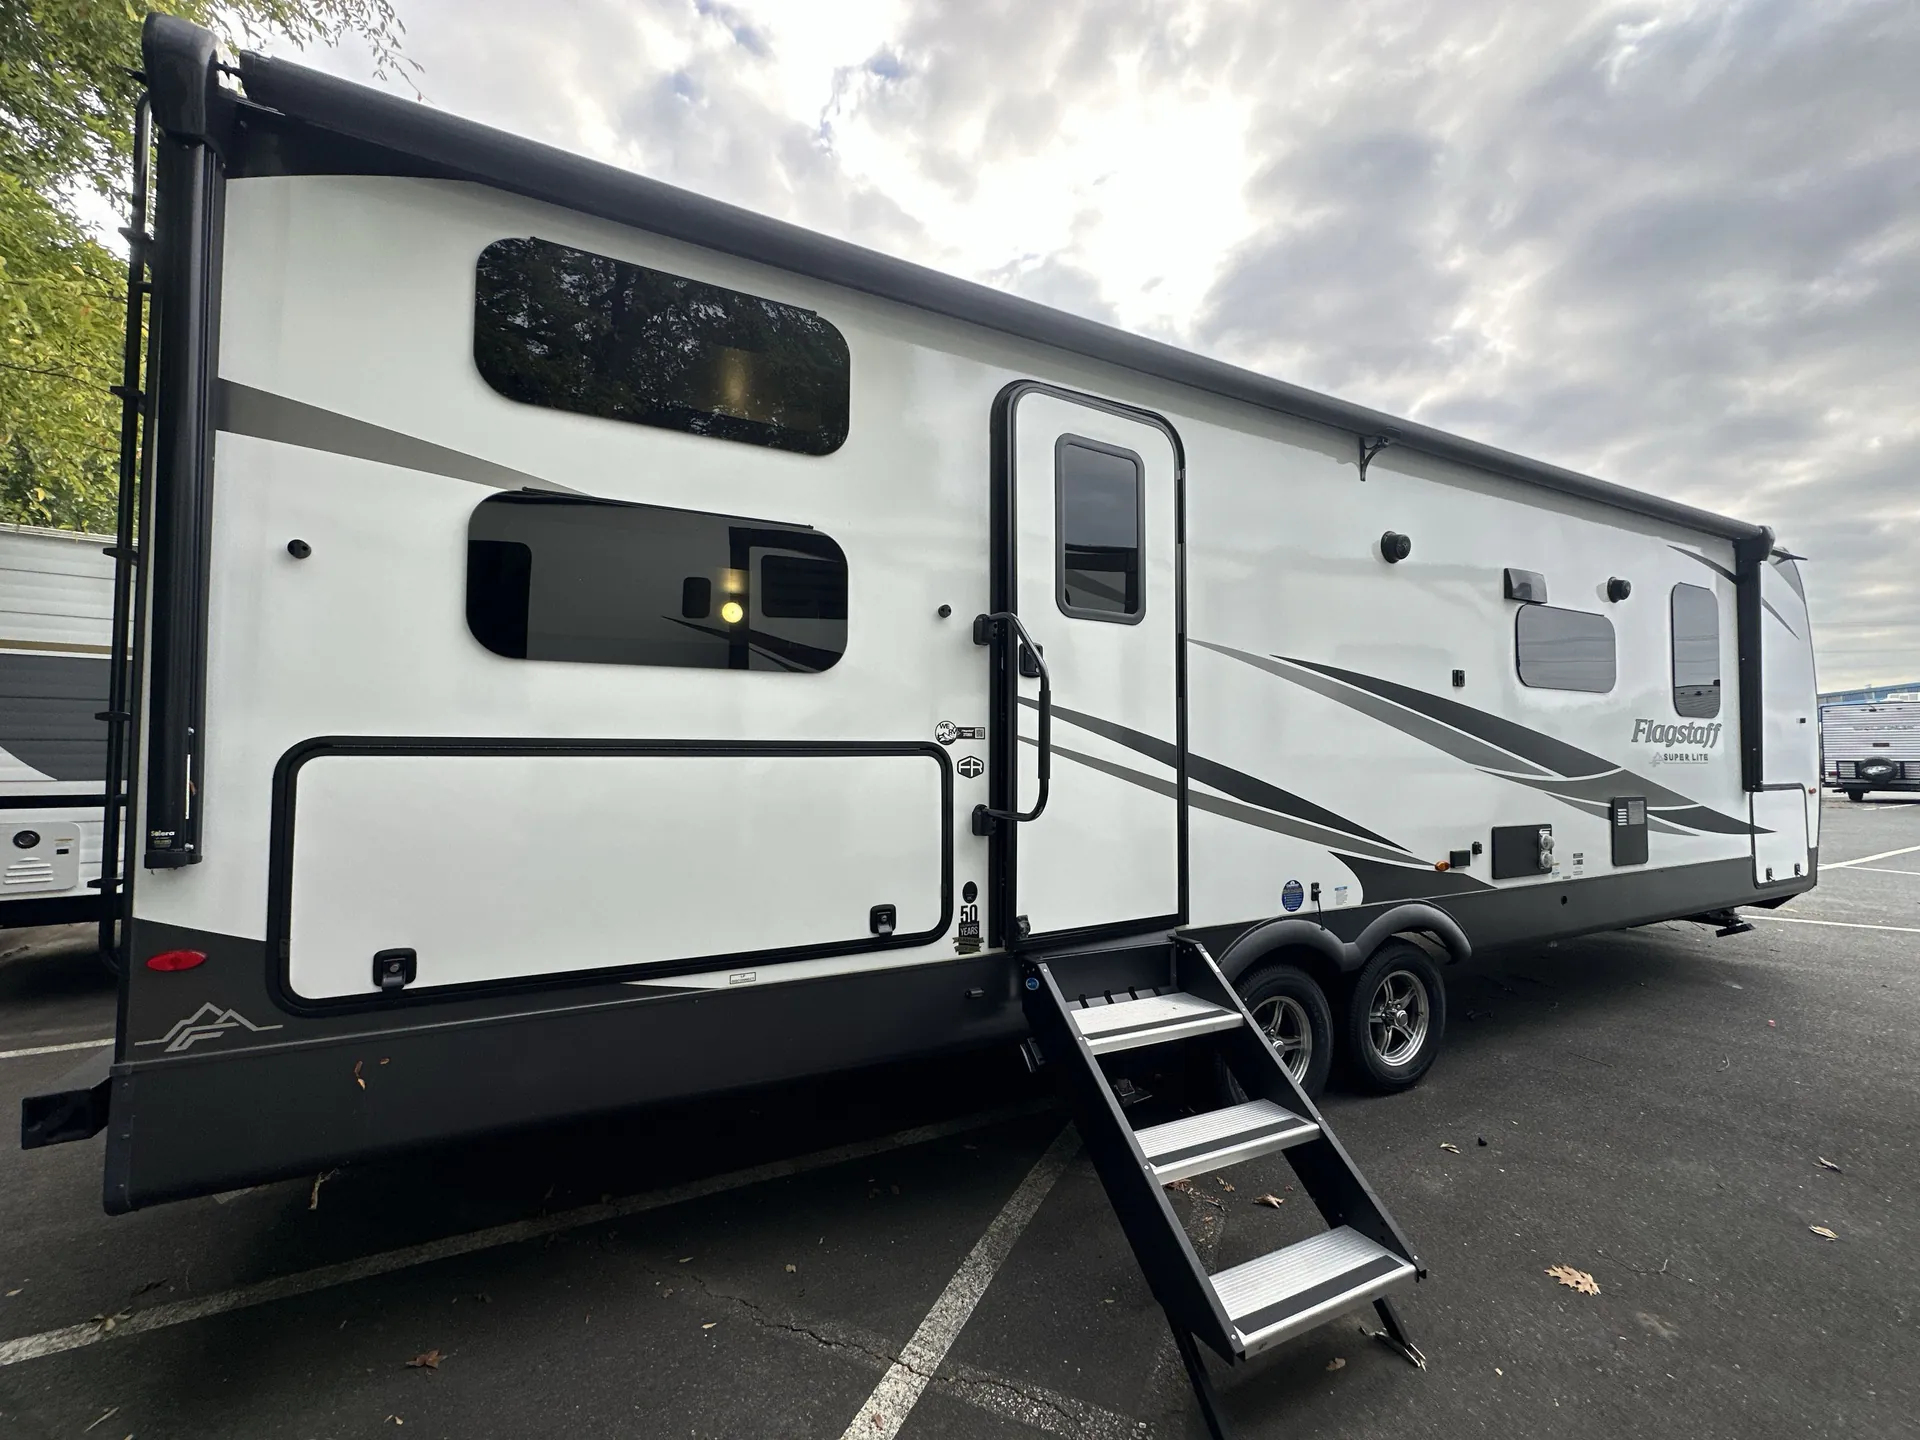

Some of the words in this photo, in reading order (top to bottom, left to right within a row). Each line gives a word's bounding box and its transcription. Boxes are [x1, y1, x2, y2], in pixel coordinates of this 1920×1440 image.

[1631, 719, 1722, 748] Flagstaff
[1663, 753, 1689, 761] SUPER
[1691, 753, 1709, 761] LITE
[960, 904, 978, 922] 50
[959, 926, 979, 936] YEARS
